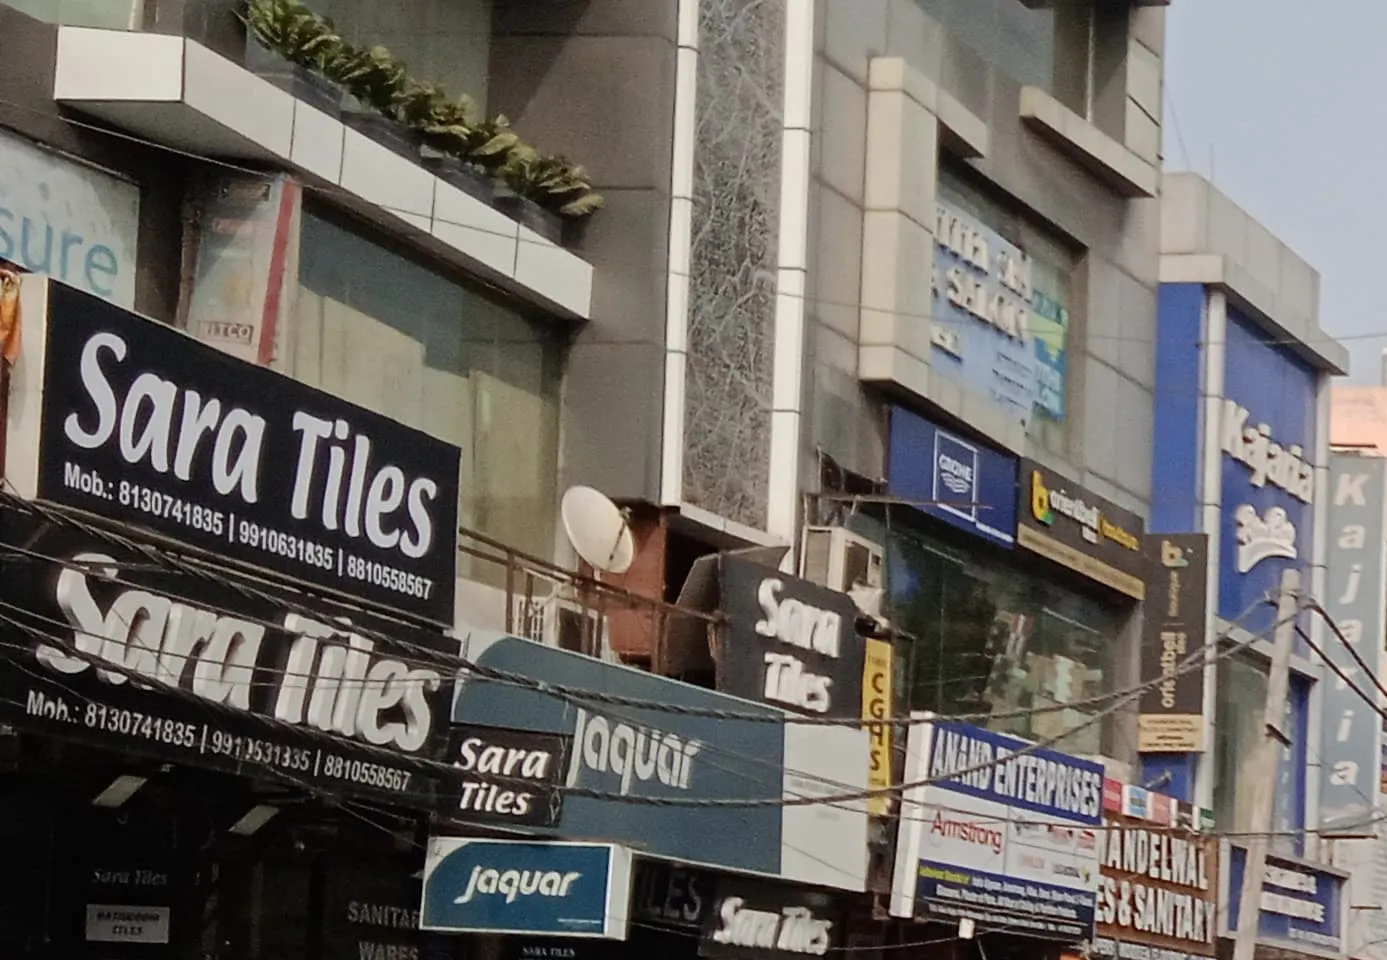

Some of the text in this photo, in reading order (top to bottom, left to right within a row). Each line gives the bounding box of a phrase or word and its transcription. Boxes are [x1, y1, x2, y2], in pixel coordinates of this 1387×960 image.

[64, 332, 438, 559] Sara Tiles
[1221, 399, 1314, 504] Kajaria
[64, 462, 433, 600] Mob.: 8130741835 9910631835 8810558567
[36, 552, 440, 752] Sara Tiles
[755, 578, 843, 659] Sara
[764, 651, 834, 712] Tiles
[85, 704, 196, 748] 8130741835
[454, 737, 551, 780] Sara
[460, 781, 534, 817] Tiles
[931, 727, 1102, 818] ANAND ENTERPRISES
[930, 810, 1003, 855] Armstrong
[1117, 881, 1133, 926] &
[1134, 884, 1216, 944] SANITARY
